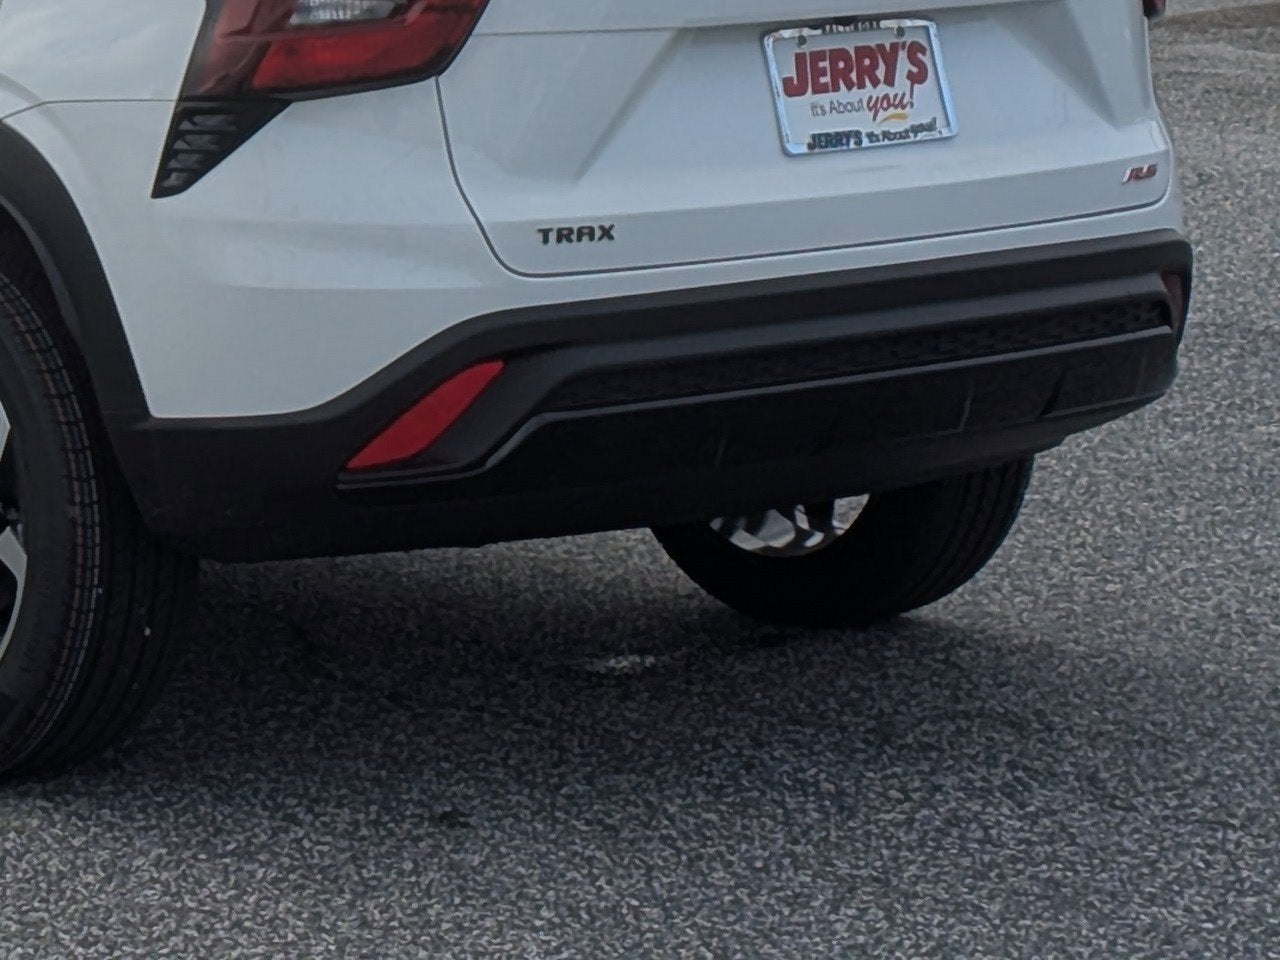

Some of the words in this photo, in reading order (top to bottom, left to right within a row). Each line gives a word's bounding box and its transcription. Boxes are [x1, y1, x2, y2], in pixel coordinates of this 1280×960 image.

[782, 41, 929, 98] JERRY'S
[830, 98, 865, 114] About
[867, 83, 915, 122] you!
[807, 129, 863, 150] JERRY'S
[537, 224, 616, 245] TRAX
